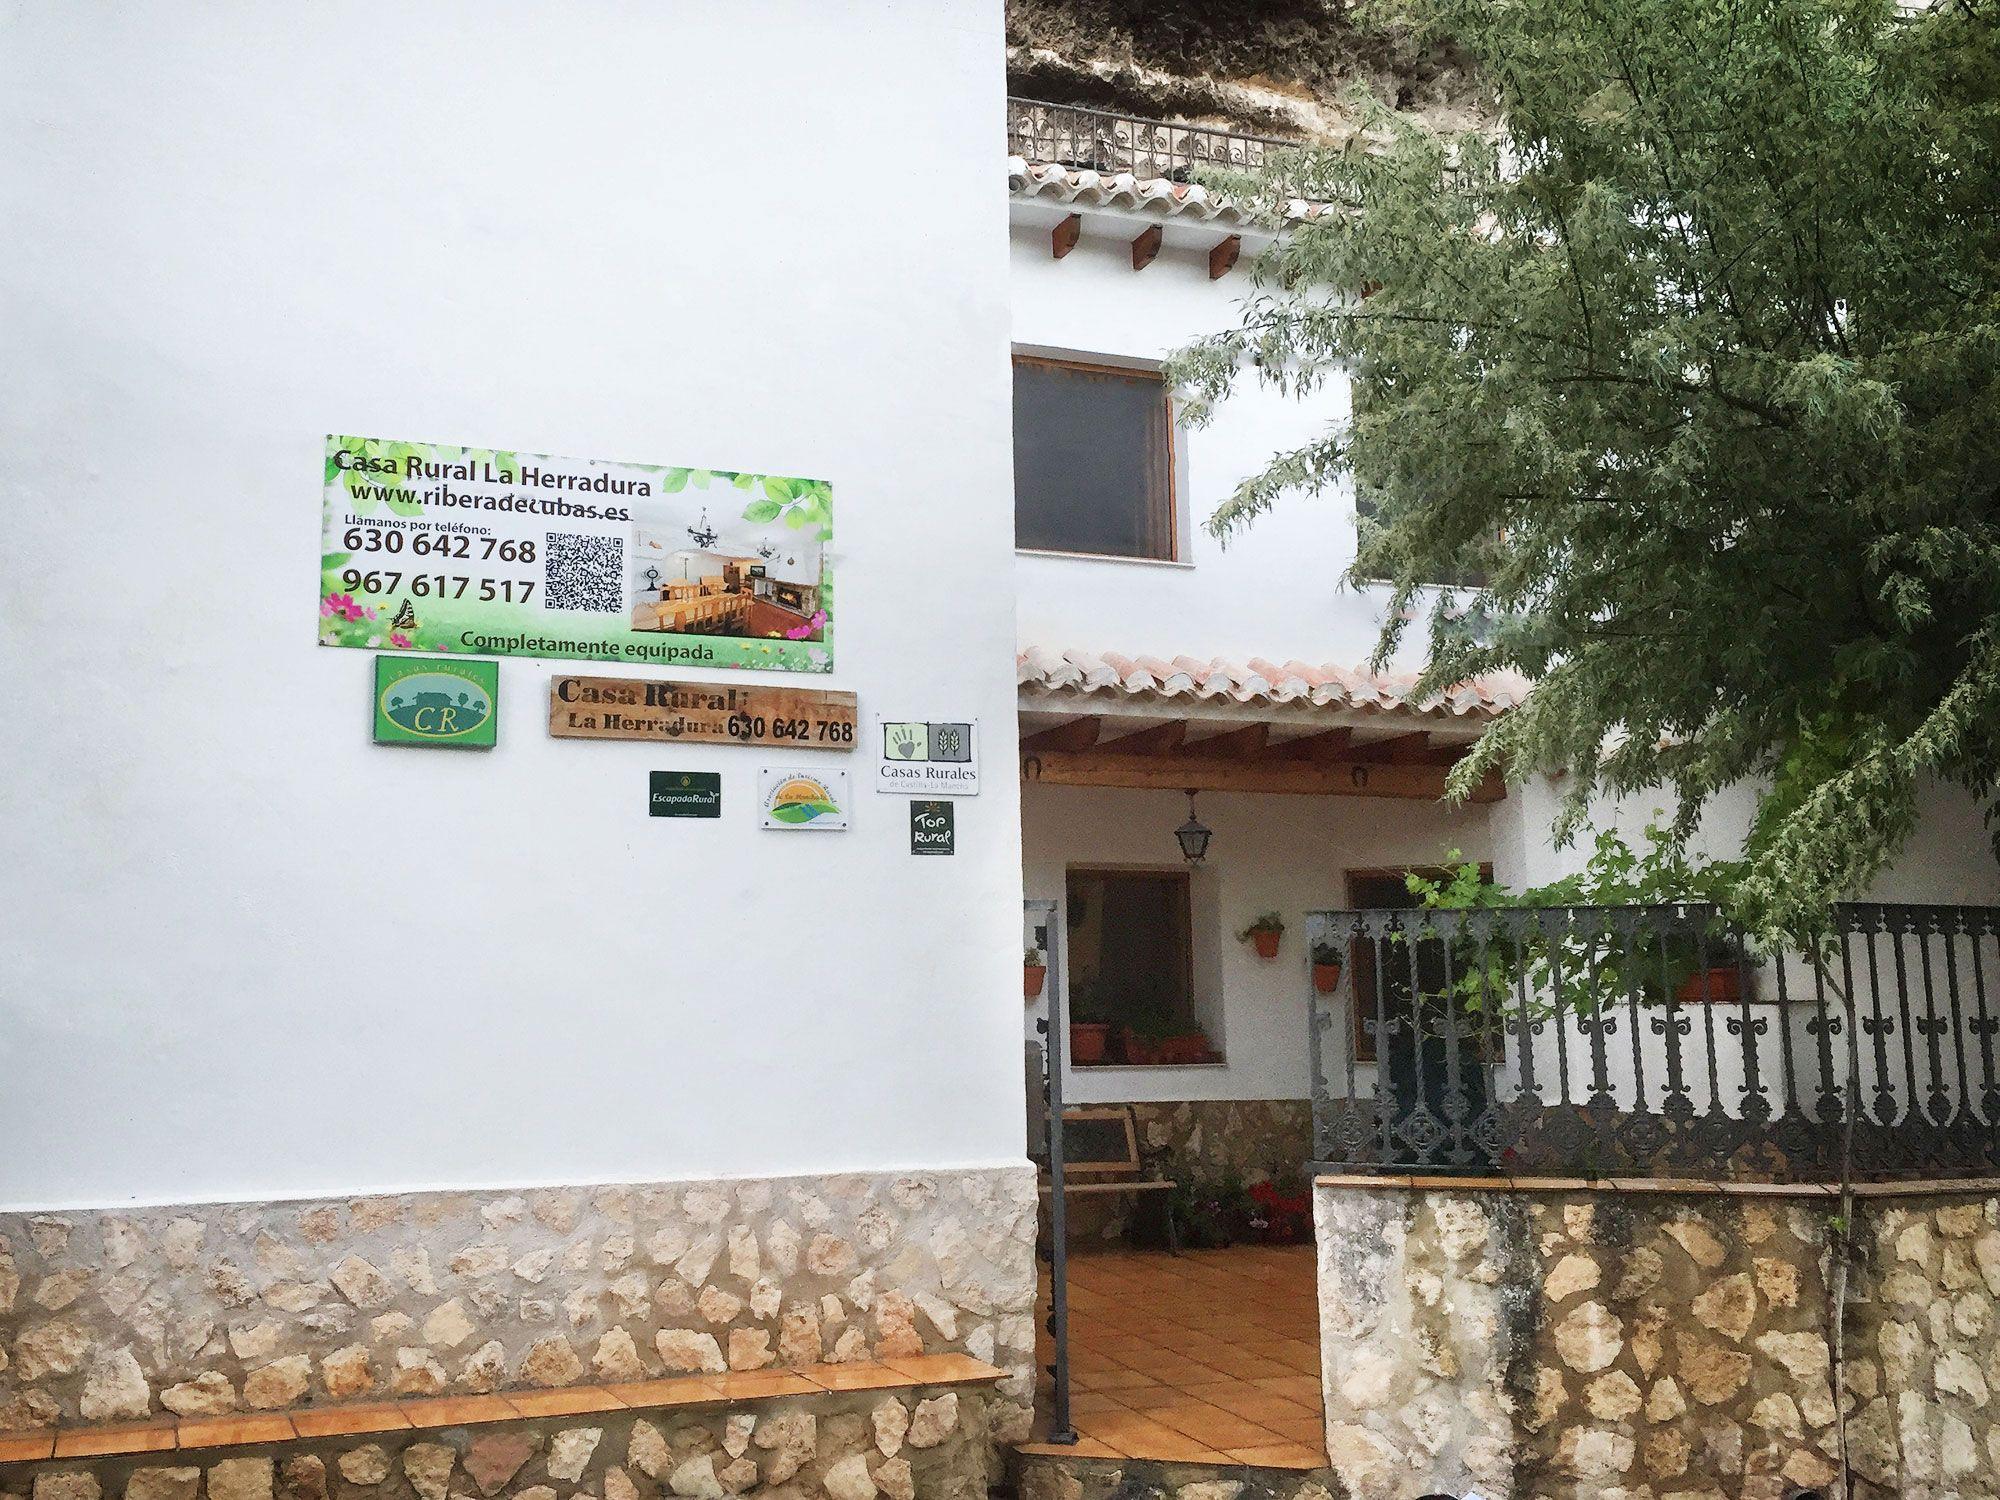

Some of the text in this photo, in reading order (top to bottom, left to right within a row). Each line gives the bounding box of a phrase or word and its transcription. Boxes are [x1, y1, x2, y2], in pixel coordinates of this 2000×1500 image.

[334, 450, 651, 496] Casa Rural La Herradura
[351, 484, 630, 520] www.riberadecubas.es
[345, 514, 491, 535] Llámanos por teléfono:
[343, 528, 536, 563] 630 642 768
[342, 569, 535, 604] 967 617 517
[461, 631, 714, 660] Completamente equipada
[558, 679, 637, 705] Casa
[568, 712, 597, 729] La
[728, 714, 766, 739] 630
[772, 718, 809, 740] 642
[816, 721, 853, 742] 768
[881, 765, 976, 780] Casas Rurales
[914, 830, 952, 845] Rural
